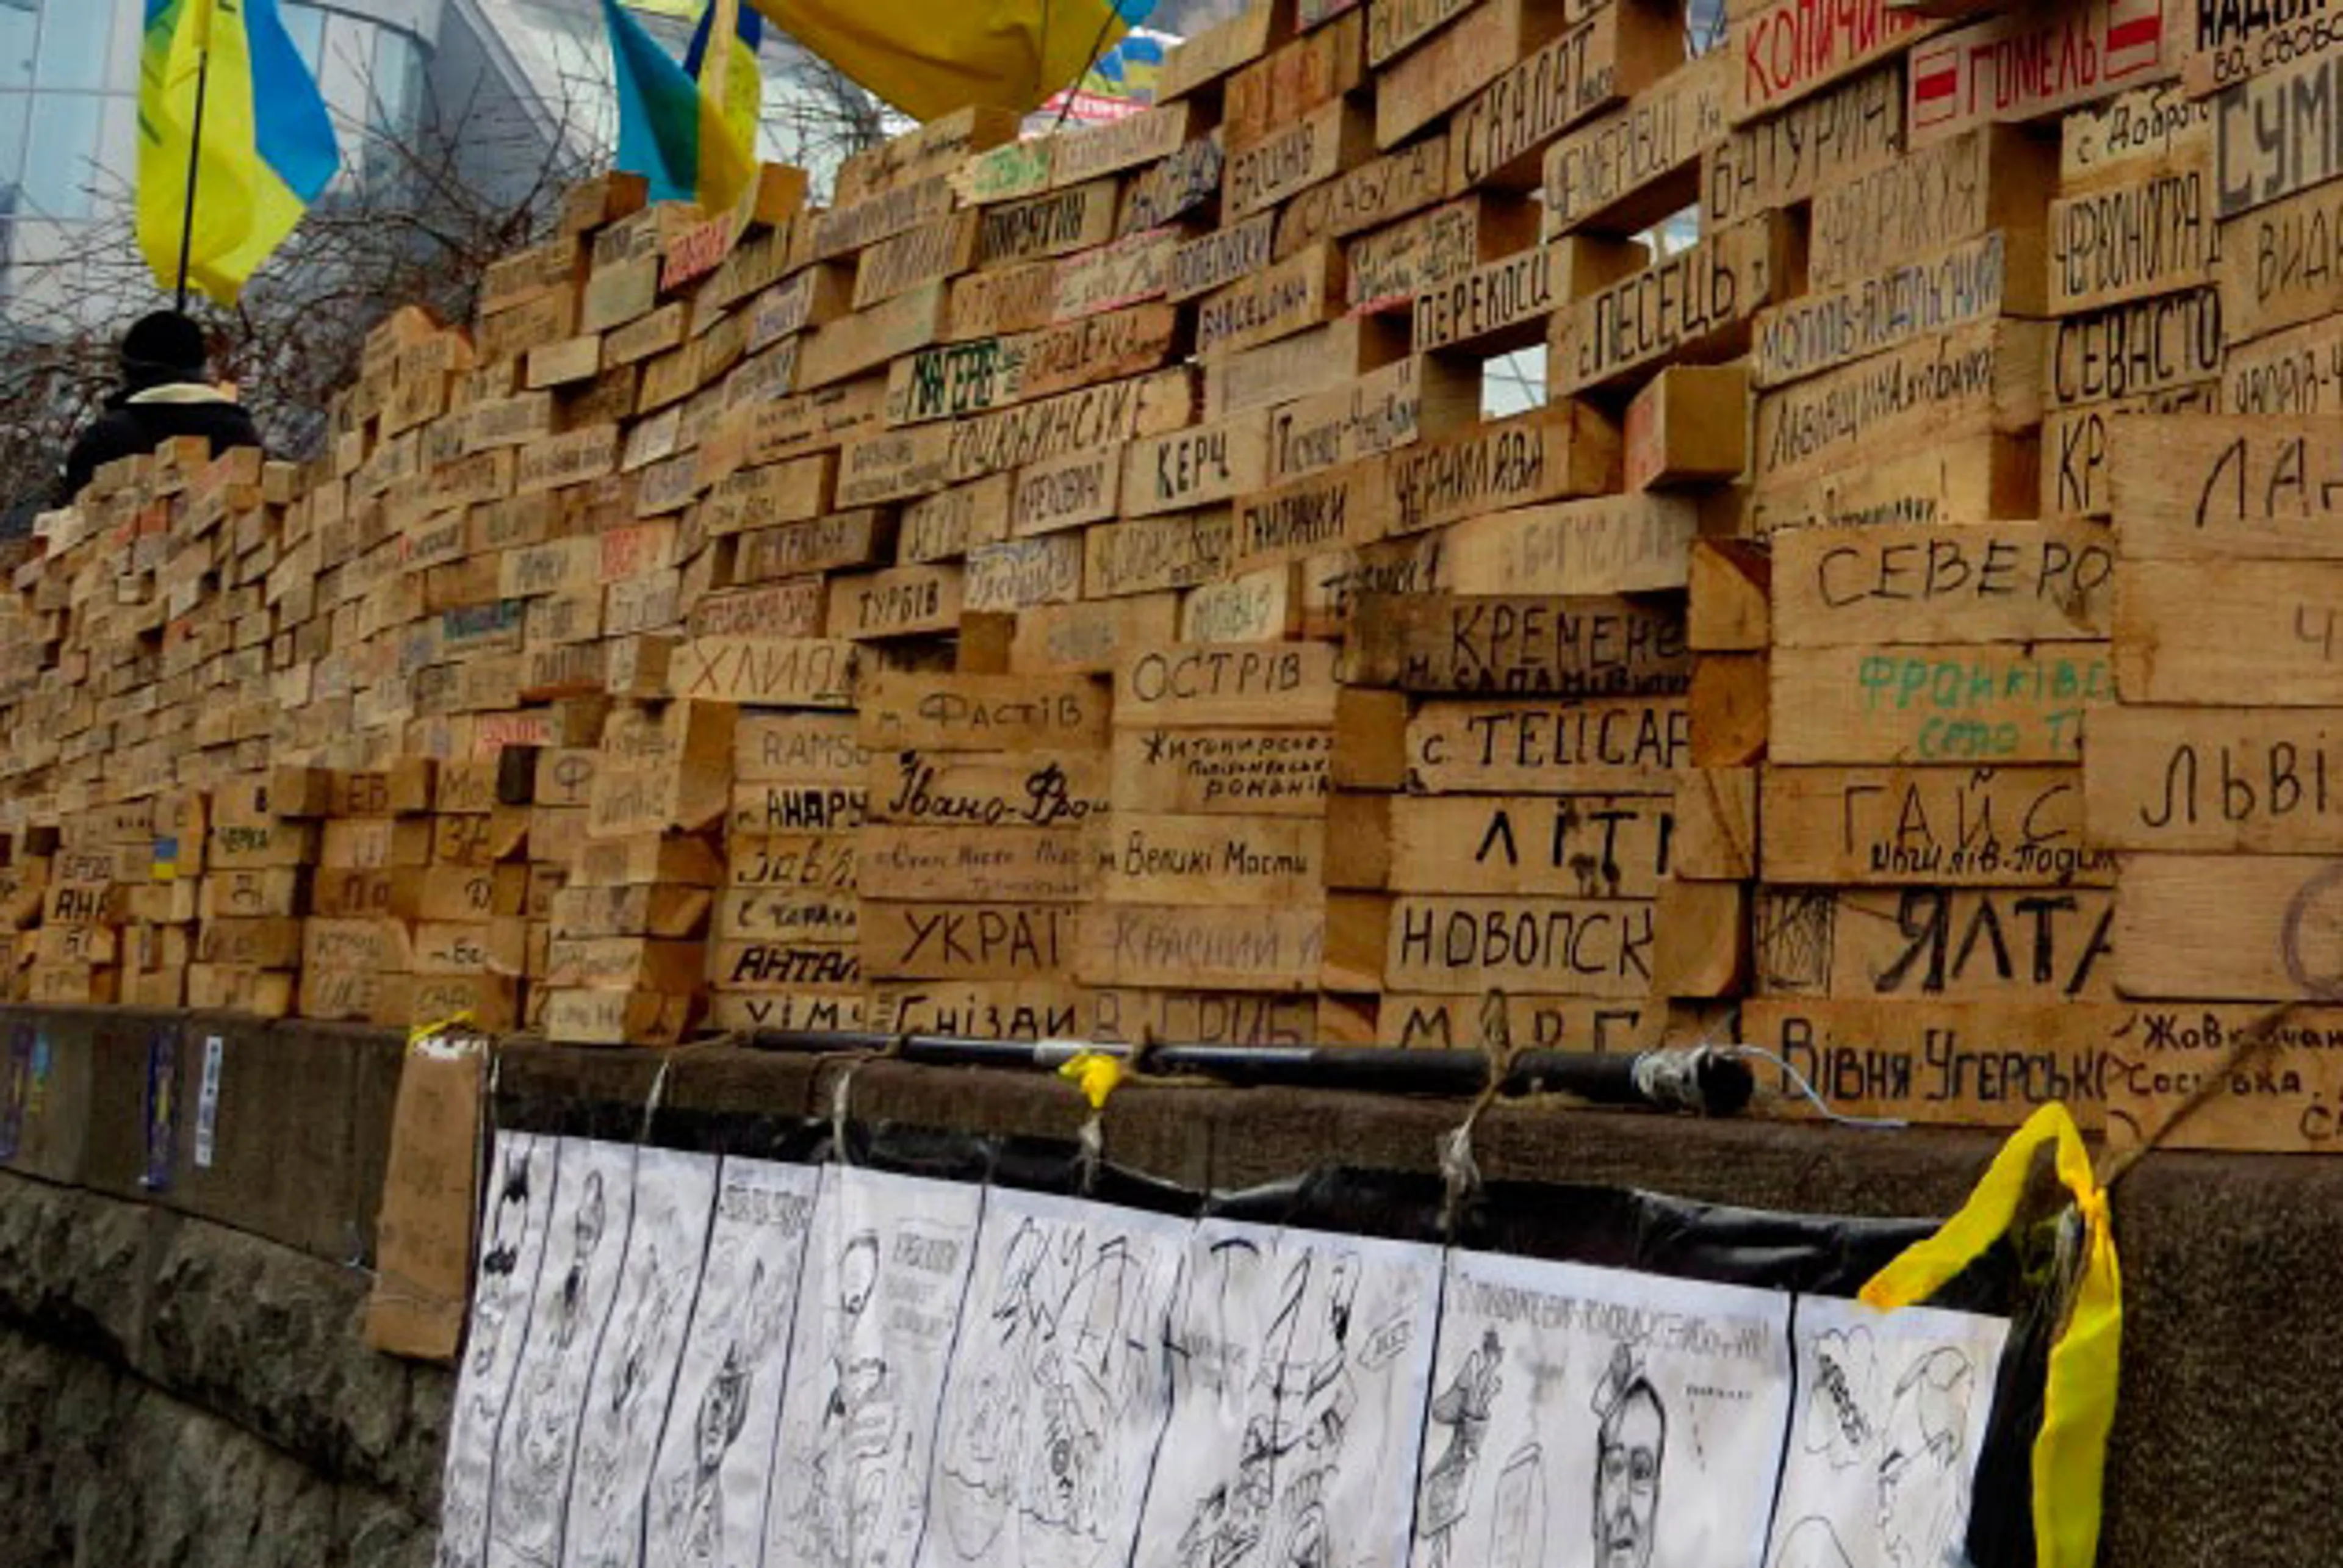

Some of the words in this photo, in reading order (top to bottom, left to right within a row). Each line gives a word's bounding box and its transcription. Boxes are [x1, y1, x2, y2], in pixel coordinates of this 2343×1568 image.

[1464, 22, 1595, 181] СКАЛАТ
[1968, 22, 2096, 116] ГОМЕЛЬ
[2056, 284, 2228, 403] СЕВАСТО
[1157, 431, 1230, 500] КЕРЧ
[1817, 539, 2114, 609] СЕВЕРО
[1132, 651, 1301, 702] ОСТРІВ
[2139, 728, 2327, 828] ЛЬВІ
[901, 909, 1071, 968] УКРАЇ
